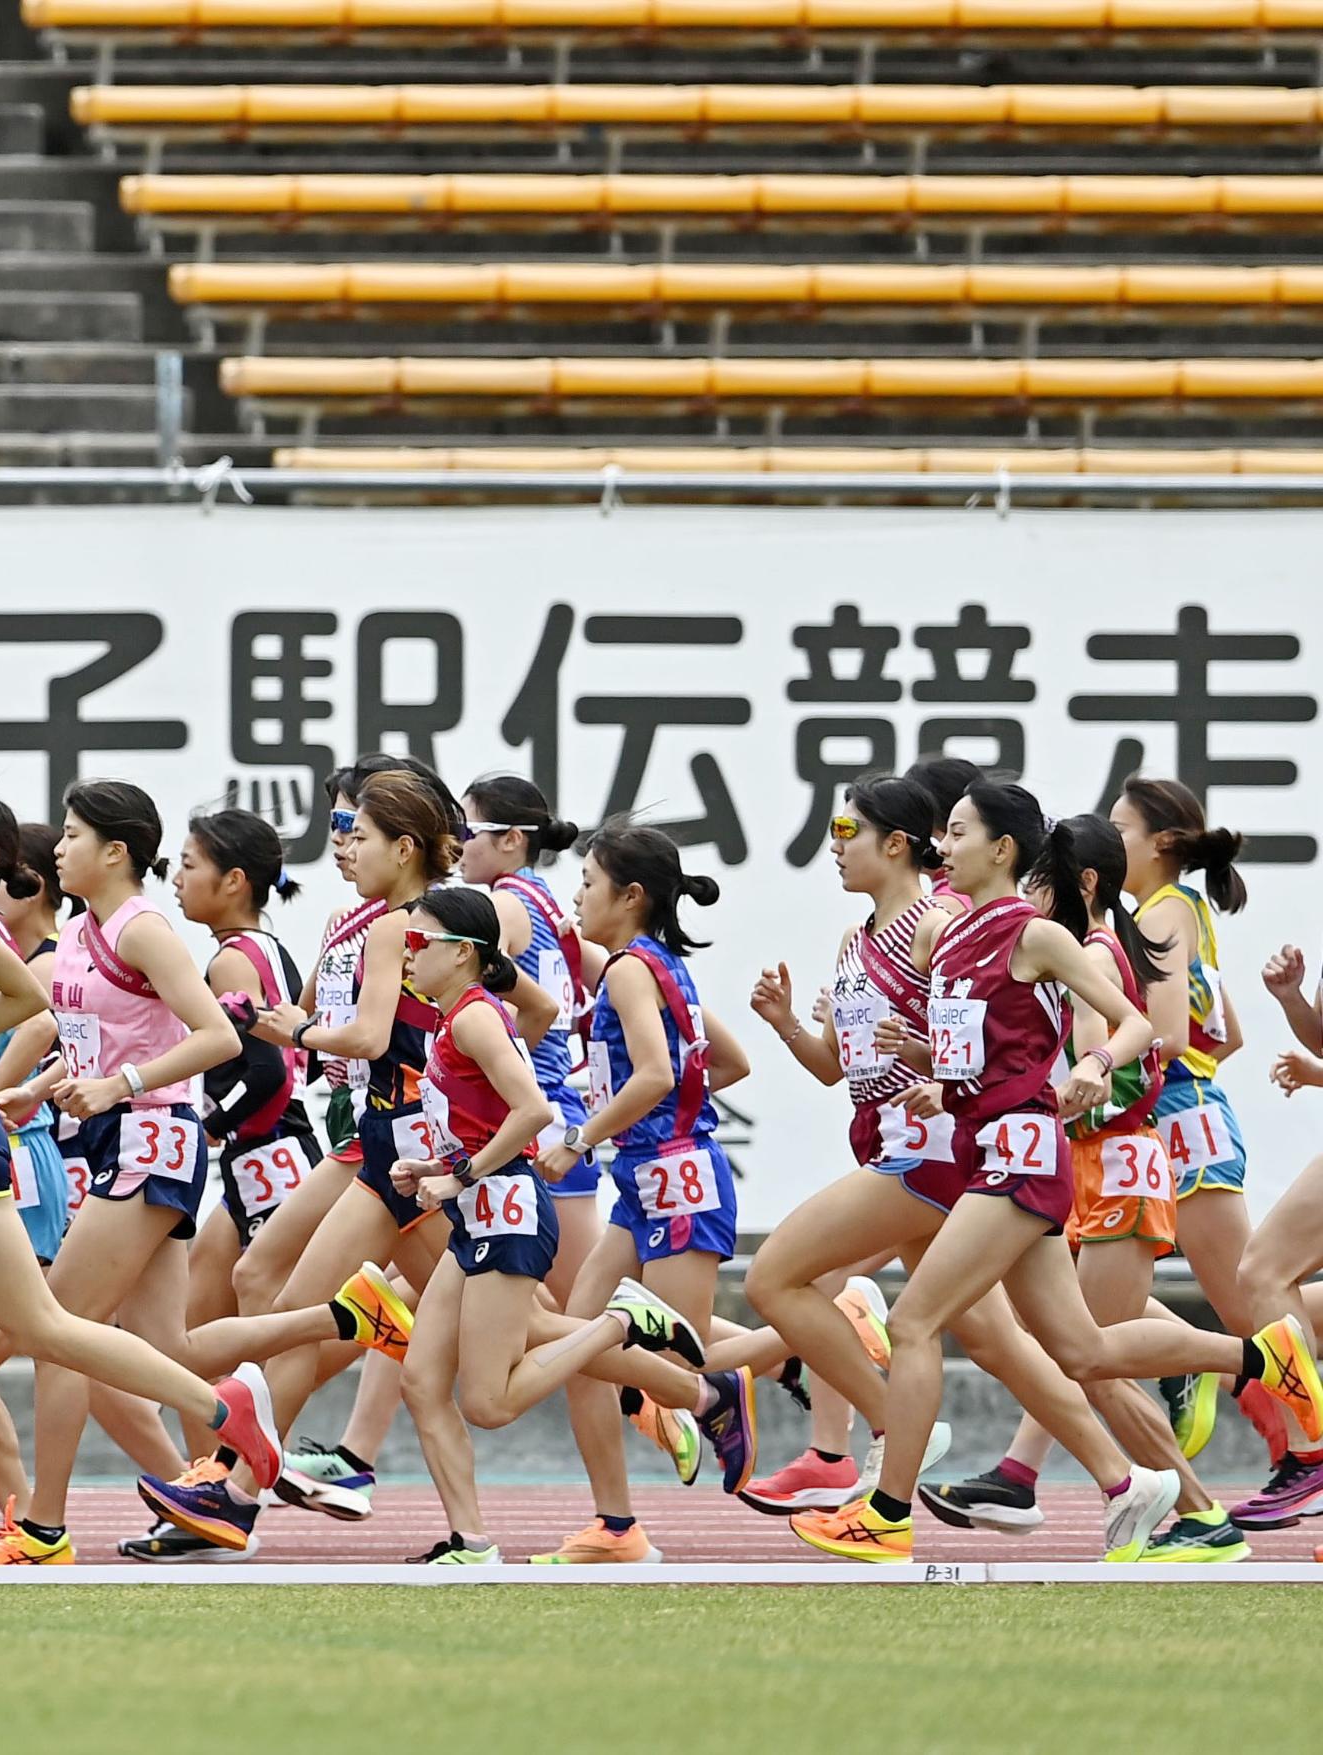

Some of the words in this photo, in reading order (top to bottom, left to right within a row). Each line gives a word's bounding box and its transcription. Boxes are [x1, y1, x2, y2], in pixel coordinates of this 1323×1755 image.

[834, 972, 868, 996] 秋田
[62, 1043, 95, 1078] 3-1
[135, 1119, 187, 1171] 33
[905, 1103, 929, 1150] 5
[994, 1121, 1043, 1168] 42
[1169, 1112, 1219, 1165] 41
[242, 1147, 302, 1202] 39
[649, 1159, 704, 1211] 28
[1116, 1142, 1161, 1190] 36
[474, 1182, 524, 1230] 46
[924, 1565, 961, 1581] B-31
